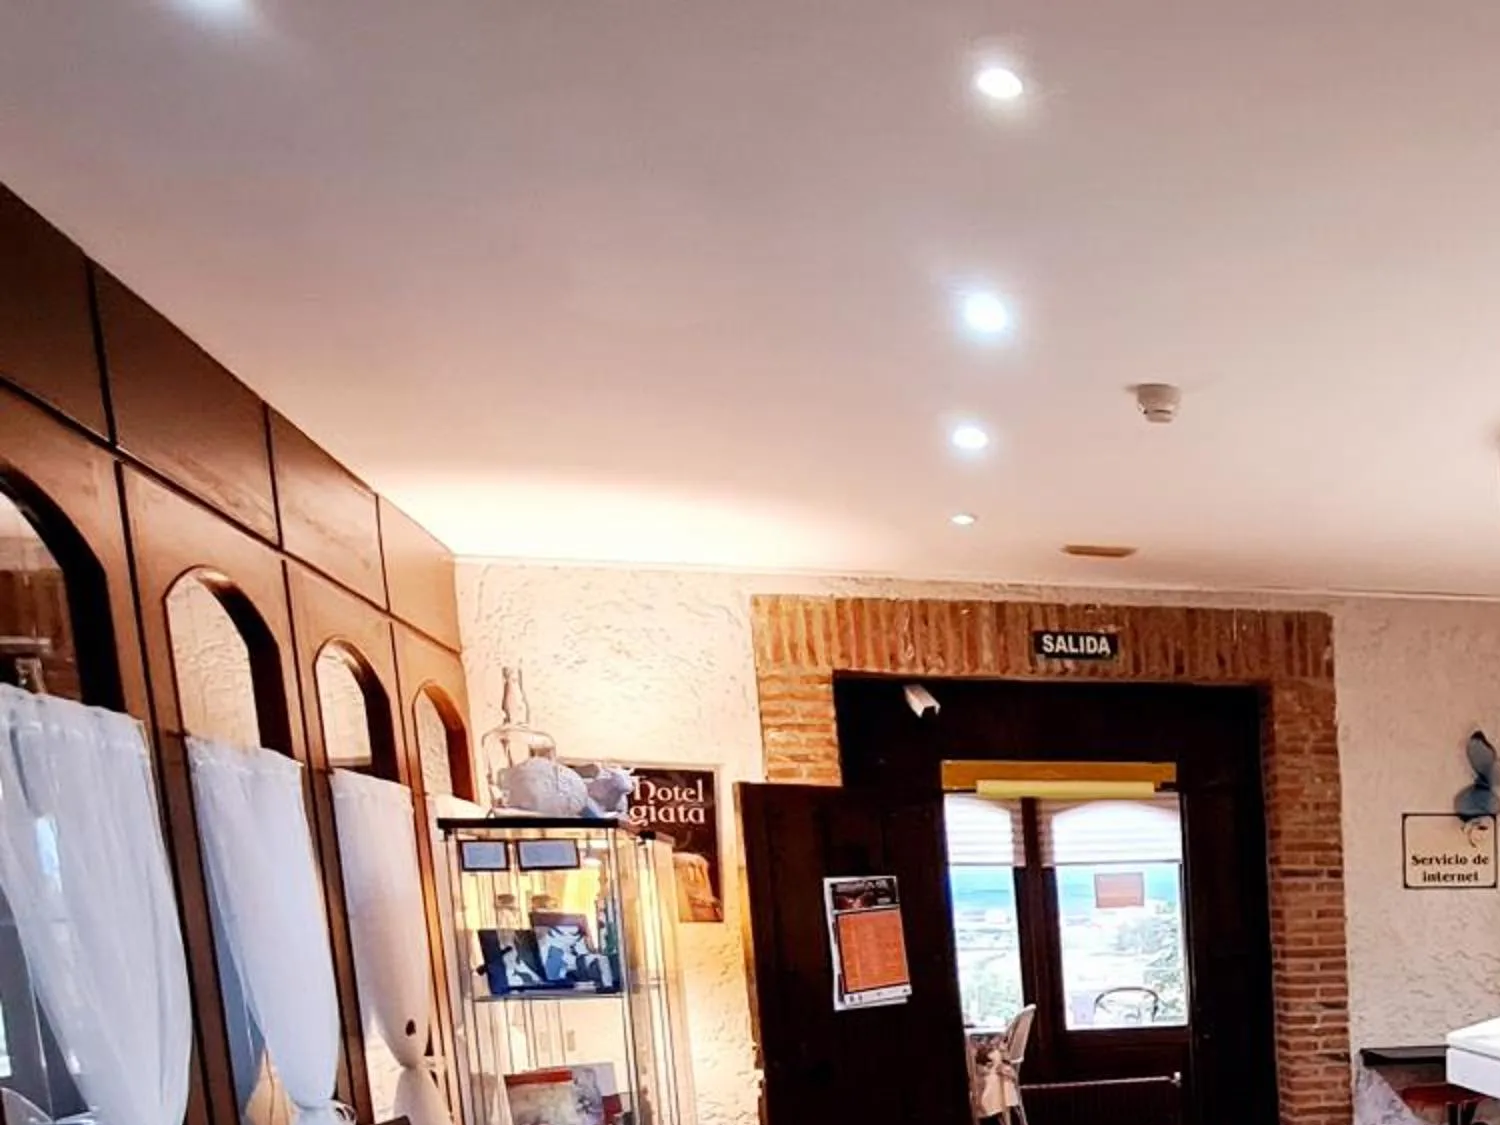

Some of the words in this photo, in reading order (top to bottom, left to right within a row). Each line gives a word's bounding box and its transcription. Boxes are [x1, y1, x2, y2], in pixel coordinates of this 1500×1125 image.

[1042, 633, 1111, 655] SALIDA
[629, 801, 705, 826] giata
[1411, 853, 1468, 866] Servicio
[1472, 853, 1489, 865] de
